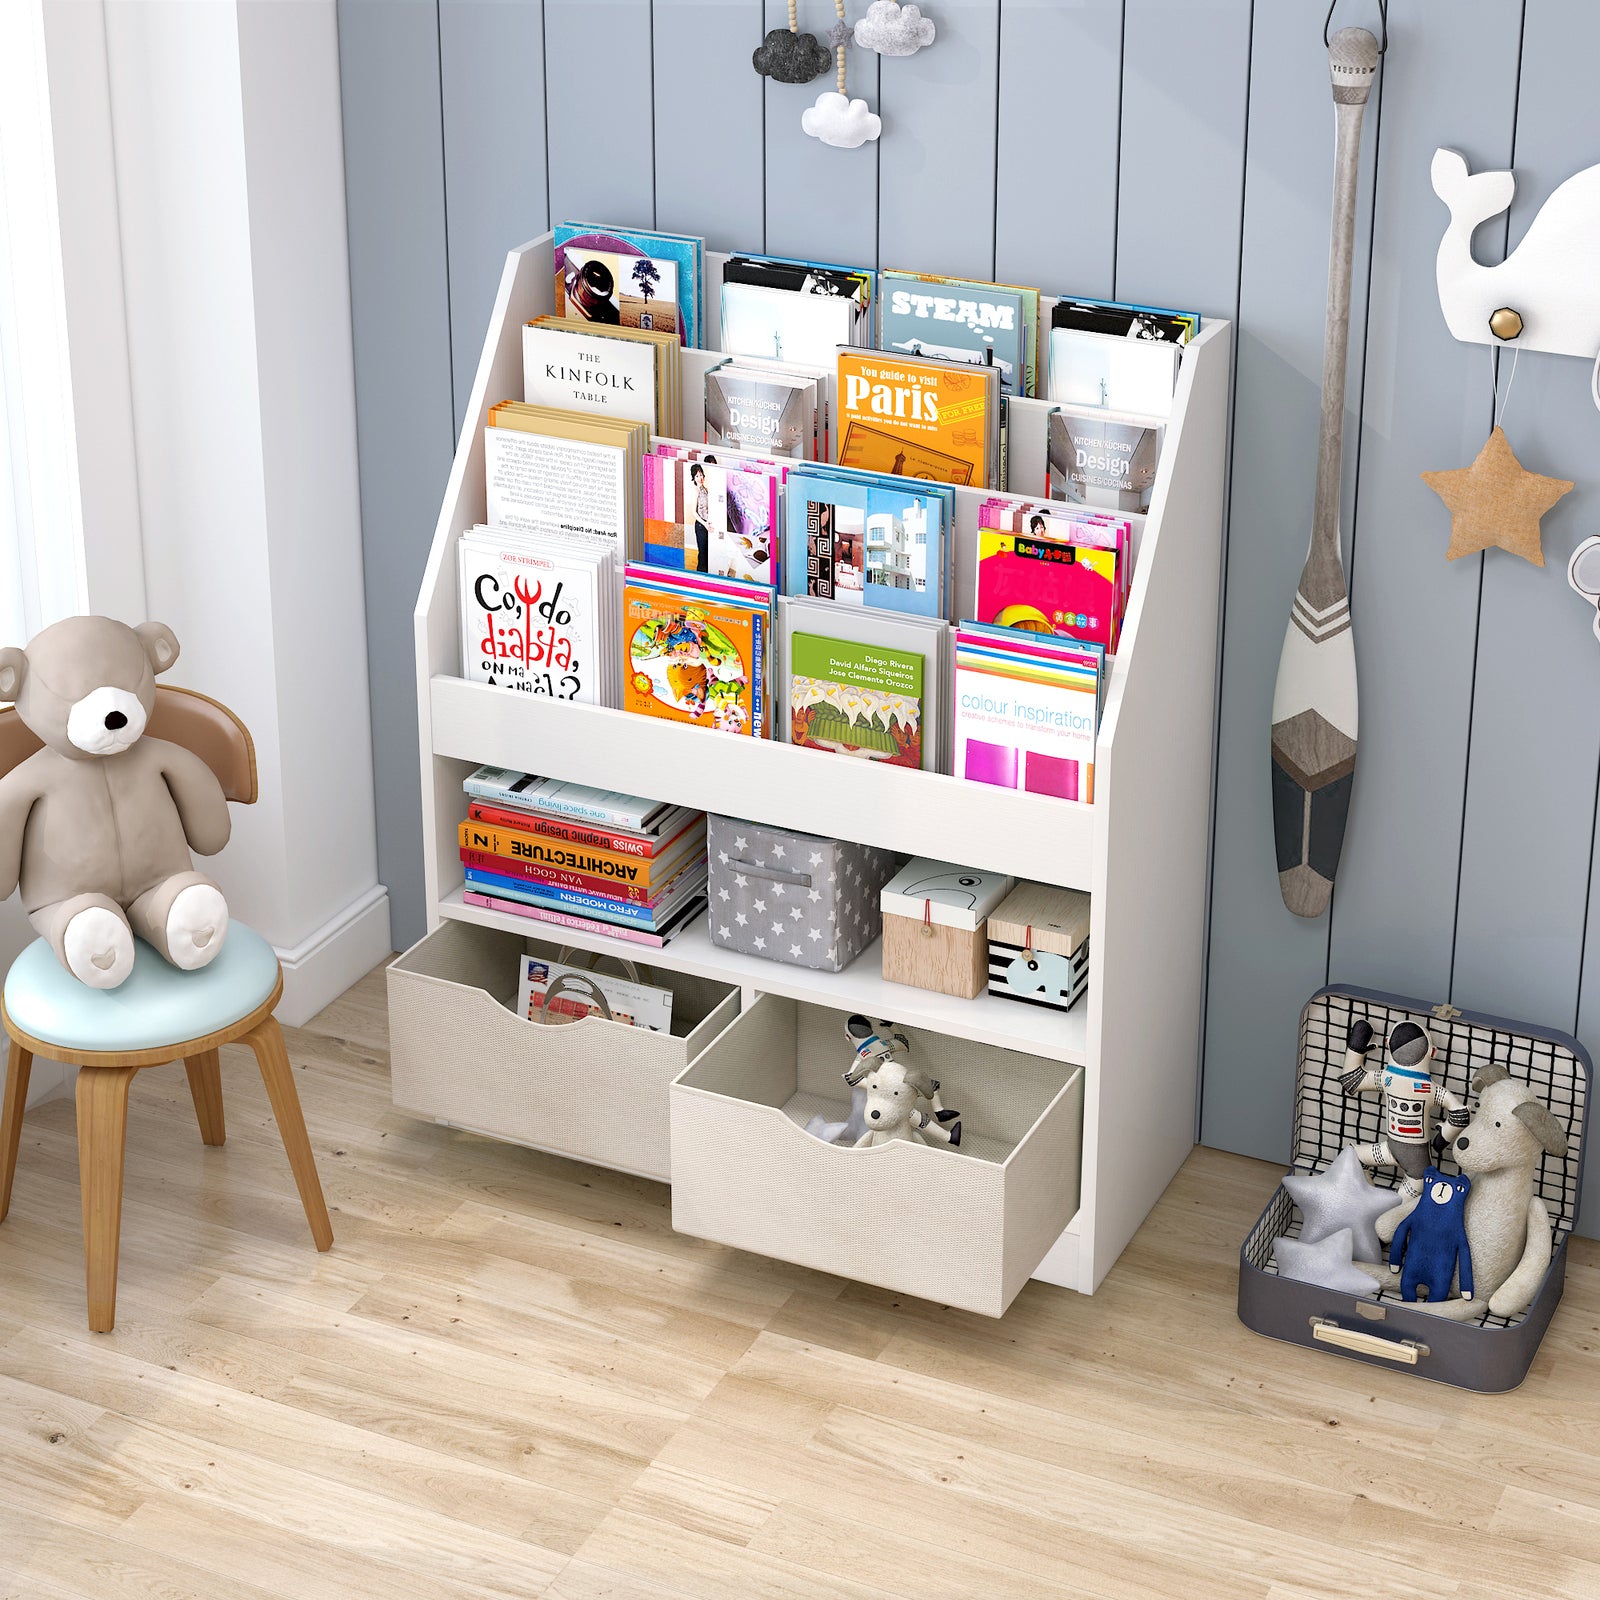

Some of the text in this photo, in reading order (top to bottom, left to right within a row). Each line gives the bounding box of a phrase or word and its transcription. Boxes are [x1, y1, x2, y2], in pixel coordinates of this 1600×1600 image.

[891, 290, 1015, 331] STEAM
[578, 352, 600, 364] THE
[546, 364, 635, 391] KINFOLK
[861, 366, 938, 386] You guide to visit
[573, 390, 608, 404] TABLE
[846, 374, 939, 422] Paris
[729, 408, 780, 434] Design
[941, 402, 985, 420] FOR FREE
[1076, 448, 1130, 476] Design
[1018, 543, 1044, 558] Baby
[518, 556, 552, 568] STRIMPEL
[475, 574, 571, 625] Co, do
[1052, 610, 1100, 631] 黄金故事
[830, 658, 914, 680] David Alfaro Siqueiros
[866, 656, 914, 670] Diego Rivera
[829, 668, 914, 689] Jose Clemente Orozco
[962, 694, 1092, 730] colour inspiration
[962, 710, 986, 720] creative
[988, 716, 1016, 727] schemes
[1026, 722, 1055, 734] transform
[1057, 728, 1071, 738] your
[1072, 732, 1090, 741] home
[538, 798, 606, 819] one space living
[534, 822, 643, 856] Swiss Graphic Design
[511, 840, 638, 880] ARCHITECTURE
[525, 865, 557, 878] GOGH
[560, 874, 583, 886] VAN
[560, 892, 638, 916] AFRO MODERN
[540, 911, 566, 923] Fellini
[566, 918, 600, 932] Federico
